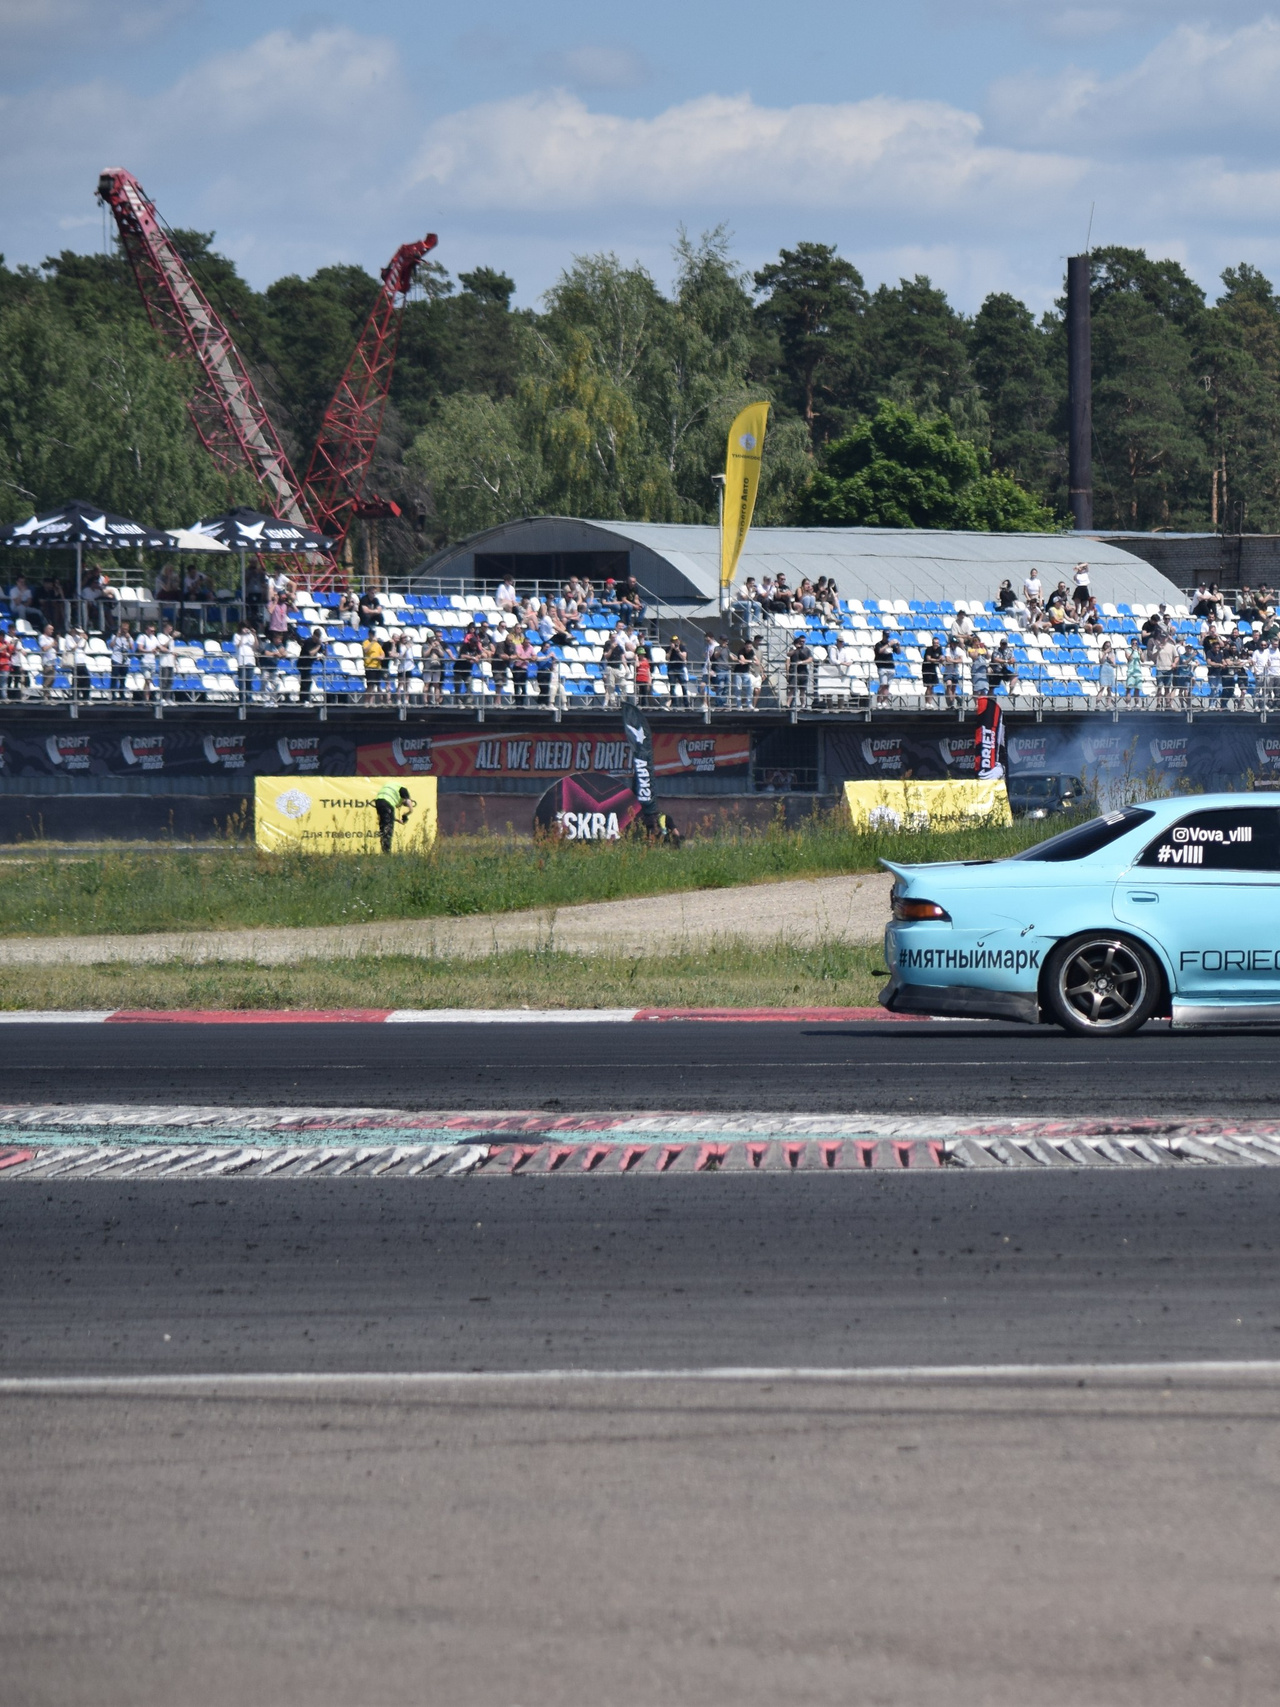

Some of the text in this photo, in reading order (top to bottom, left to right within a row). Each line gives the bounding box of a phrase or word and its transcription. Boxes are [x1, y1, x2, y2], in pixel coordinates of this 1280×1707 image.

[58, 737, 90, 748] DRIFT
[133, 737, 164, 749] DRIFT
[215, 736, 246, 748] DRIFT
[290, 738, 320, 749] DRIFT
[404, 738, 432, 750] DRIFT
[688, 740, 715, 751] DRIFT
[873, 739, 902, 750] DRIFT
[981, 725, 992, 768] DRIFT
[1018, 738, 1047, 749] DRIFT
[1093, 738, 1121, 749] DRIFT
[1160, 738, 1188, 750] DRIFT
[475, 742, 634, 770] ALL WE NEED IS DRIFT
[900, 942, 1040, 974] #мятныймарк
